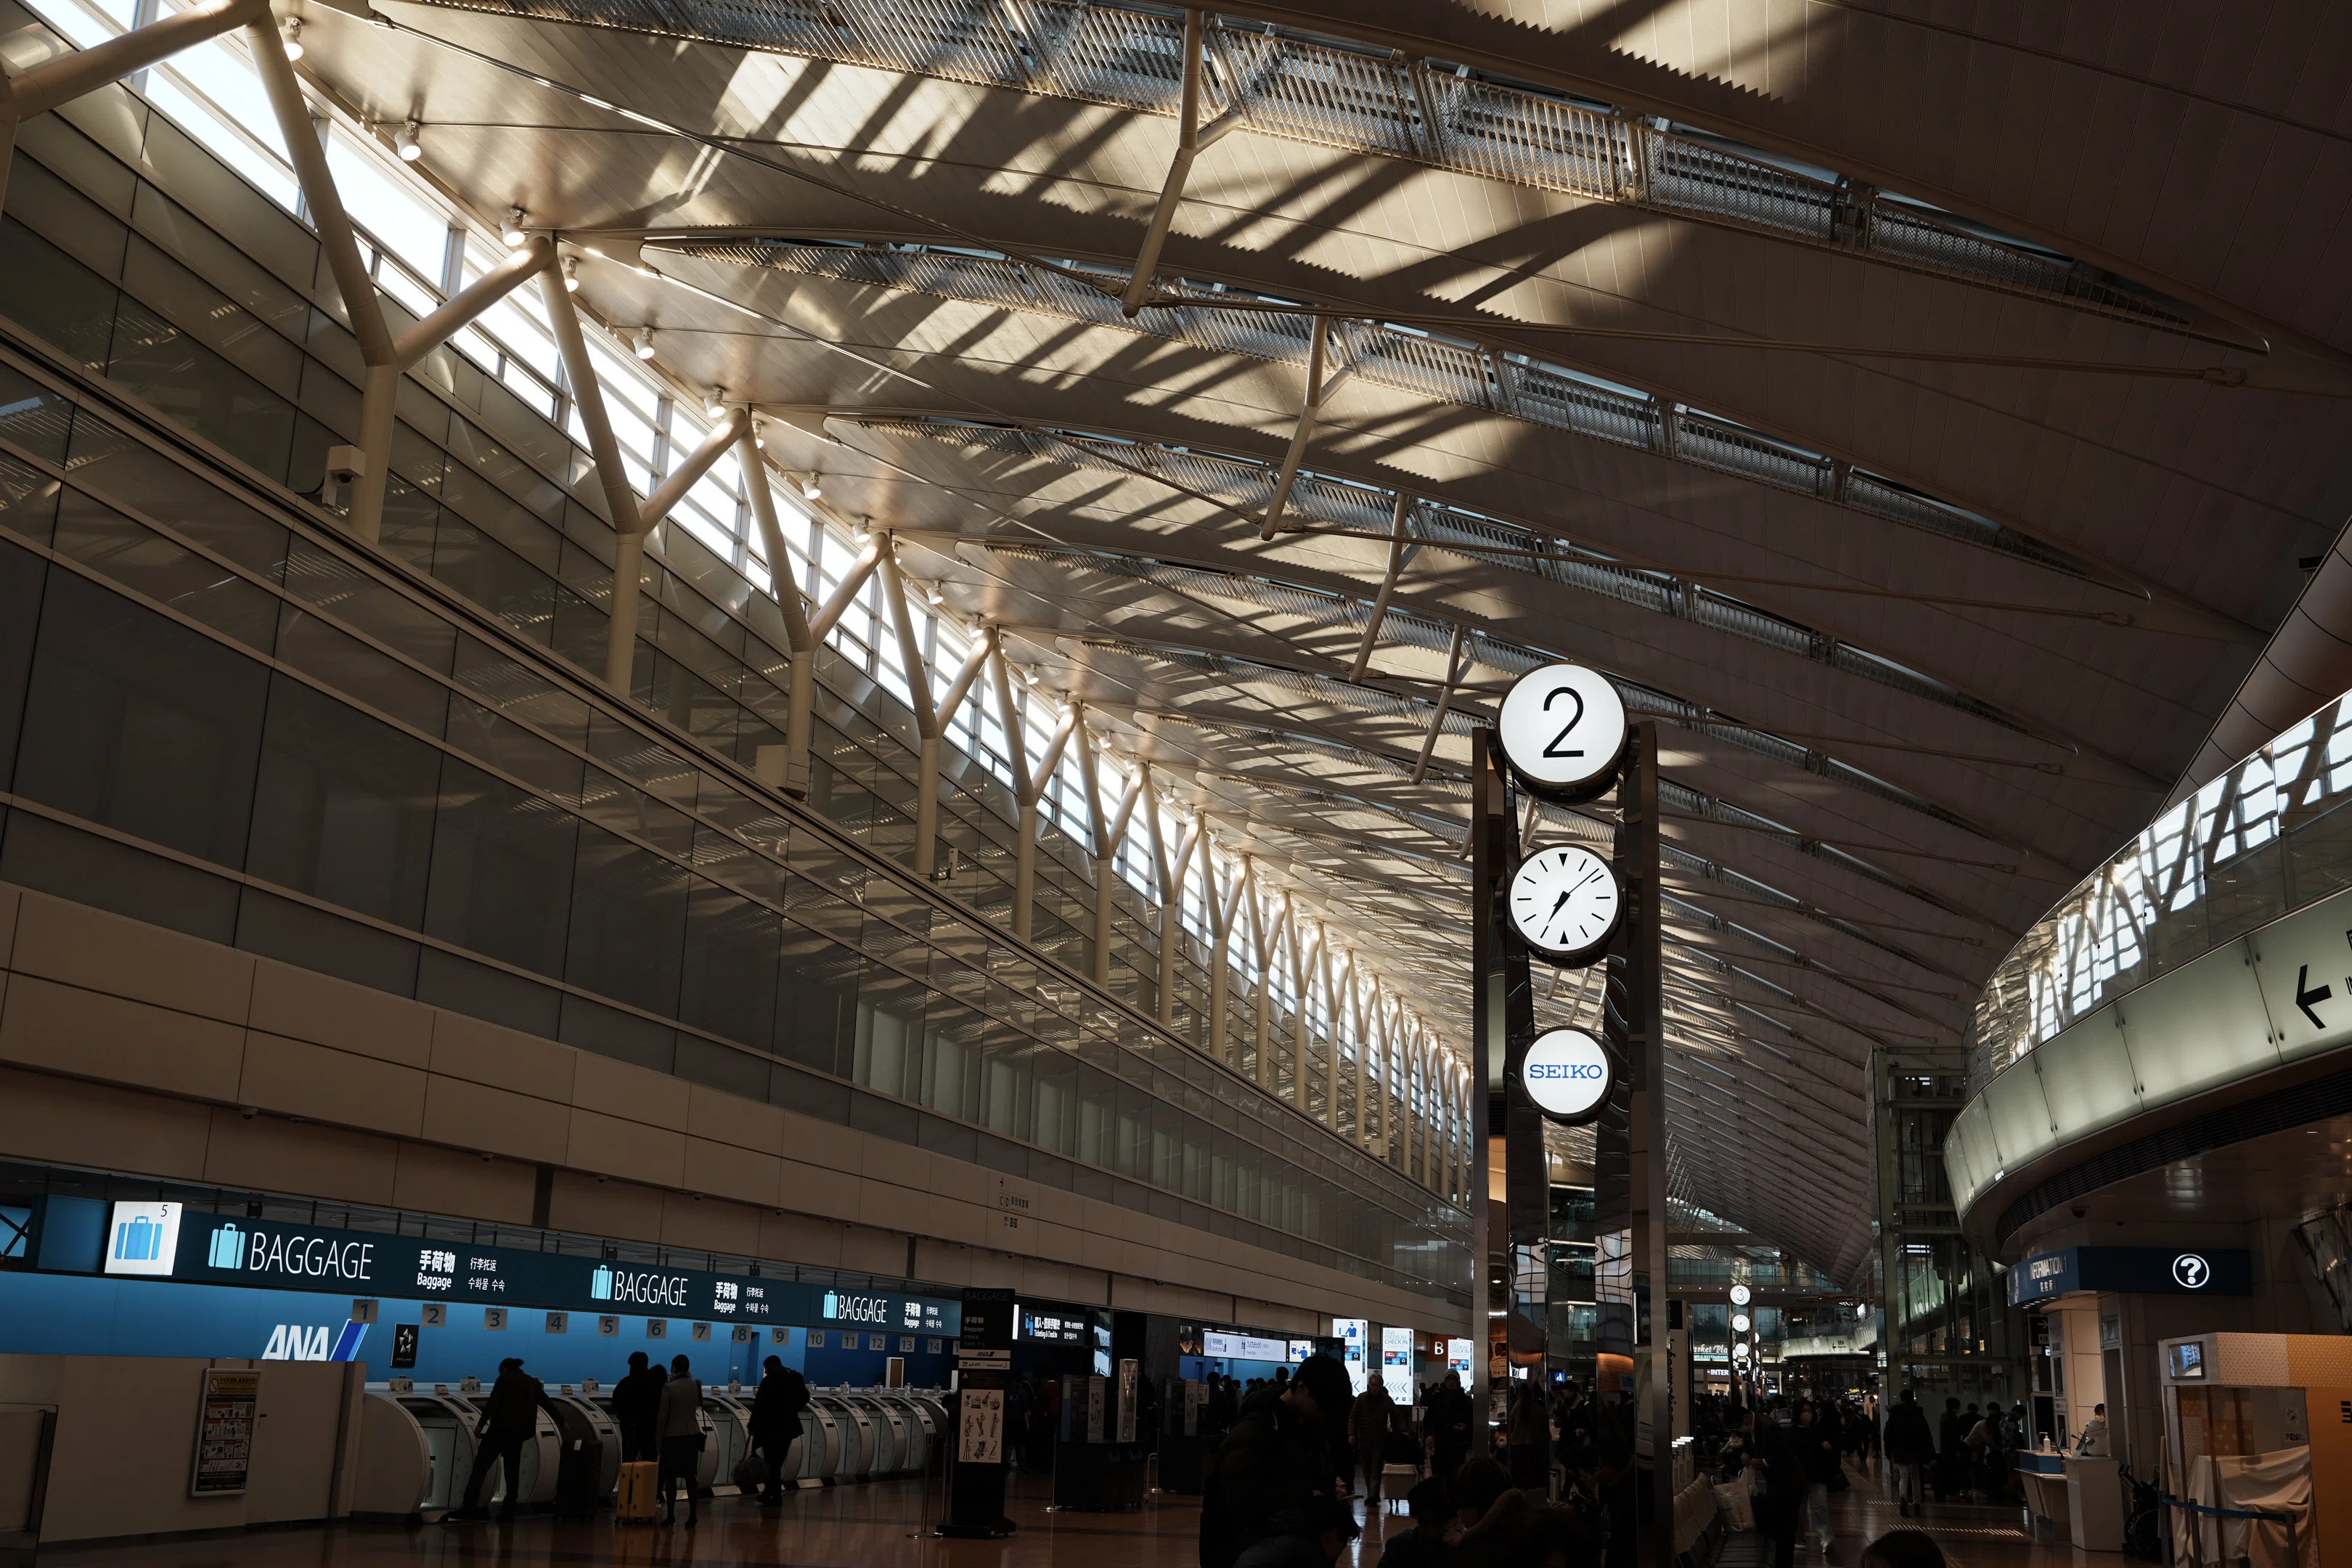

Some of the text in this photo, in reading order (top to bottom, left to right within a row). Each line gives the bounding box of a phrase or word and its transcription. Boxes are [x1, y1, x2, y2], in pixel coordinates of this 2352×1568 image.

[1543, 687, 1585, 759] 2
[1529, 1063, 1603, 1079] SEIKO
[160, 1204, 168, 1217] 5
[249, 1231, 374, 1280] BAGGAGE
[419, 1249, 456, 1273] 手荷物
[2064, 1254, 2067, 1272] 1
[470, 1257, 497, 1272] 行李托运
[416, 1272, 452, 1291] Baggage
[467, 1276, 505, 1292] 수화물 수속
[614, 1270, 688, 1307] BAGGAGE
[715, 1281, 738, 1300] 手荷物
[965, 1291, 1010, 1302] BAGGAGE
[1736, 1289, 1744, 1302] 3
[361, 1304, 368, 1320] 1
[714, 1299, 736, 1314] Baggage
[838, 1294, 887, 1323] BAGGAGE
[905, 1302, 921, 1318] 手荷物
[427, 1307, 439, 1323] 2
[490, 1312, 500, 1327] 3
[904, 1316, 920, 1328] Baggage
[550, 1315, 562, 1331] 4
[603, 1320, 613, 1334] 5
[651, 1323, 661, 1336] 6
[698, 1326, 706, 1339] 7
[738, 1328, 747, 1341] 8
[776, 1331, 784, 1343] 9
[810, 1334, 822, 1346] 10
[261, 1323, 330, 1361] ANA
[844, 1336, 854, 1347] 11
[871, 1339, 883, 1348] 12
[902, 1340, 912, 1350] 13
[929, 1342, 940, 1352] 14
[1434, 1341, 1444, 1355] B
[1693, 1343, 1728, 1354] arket Pla
